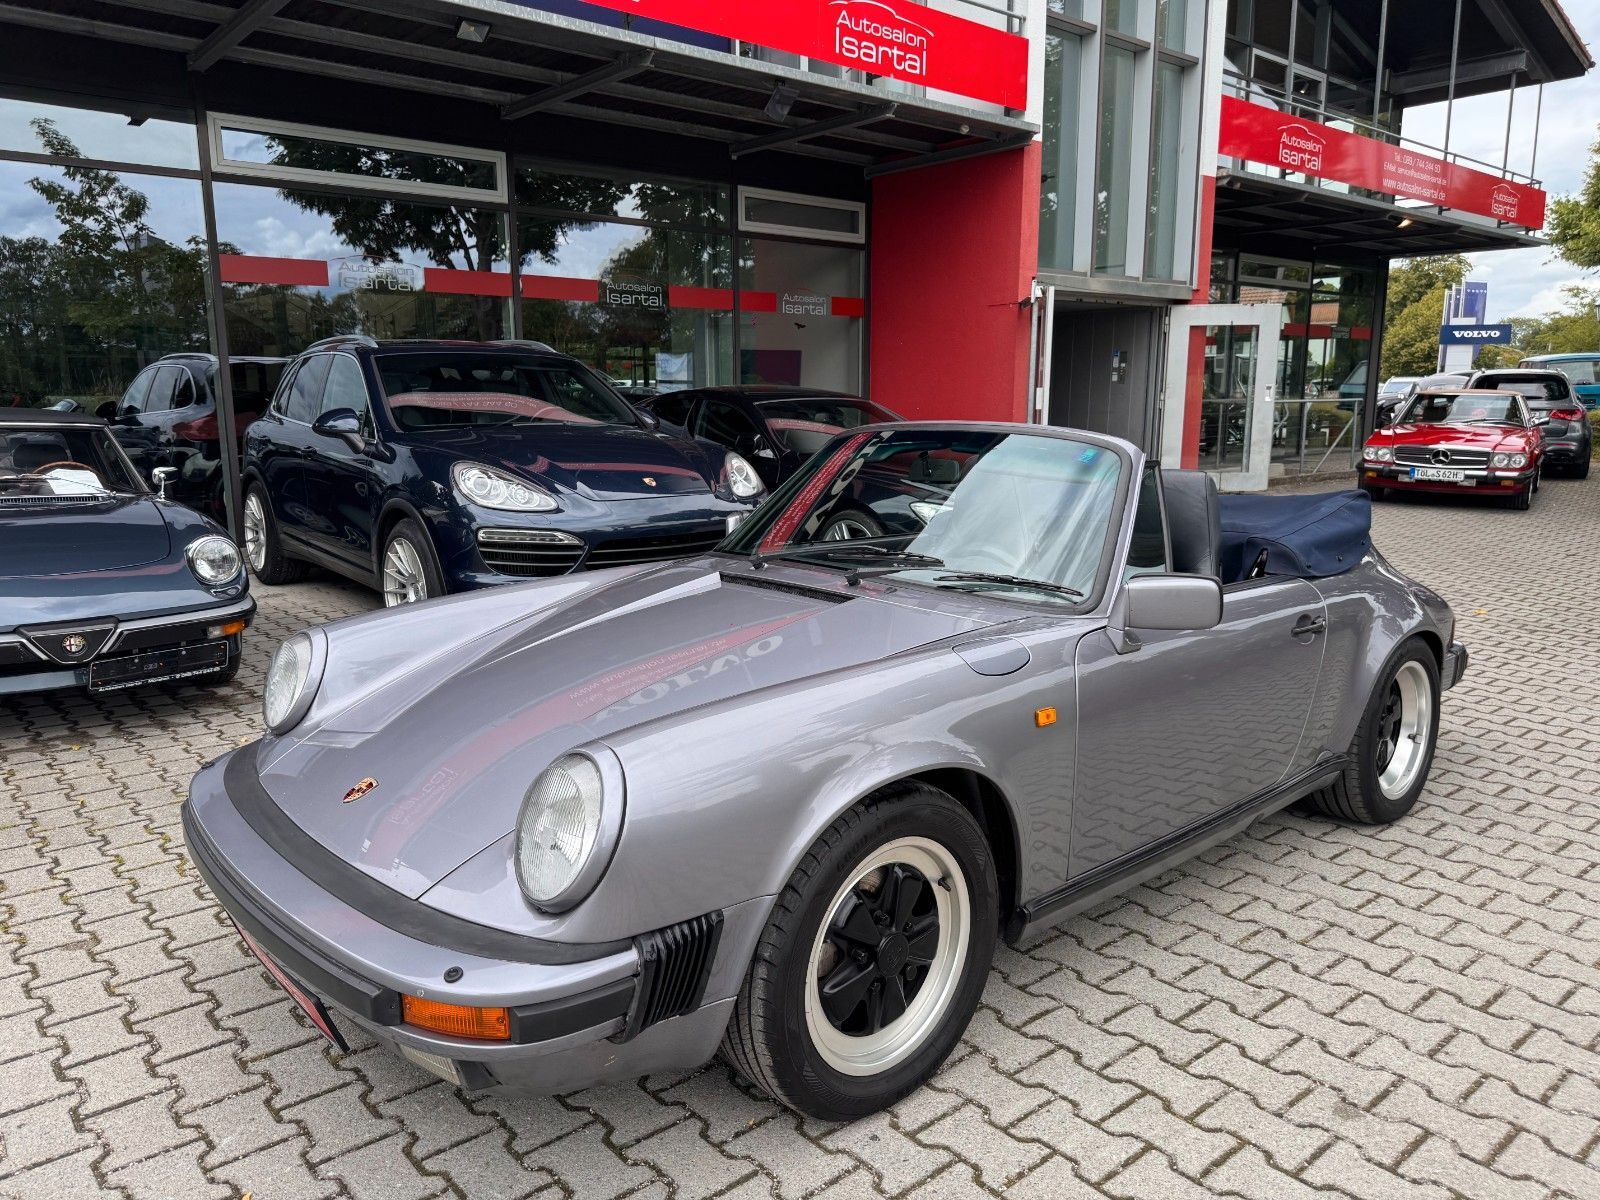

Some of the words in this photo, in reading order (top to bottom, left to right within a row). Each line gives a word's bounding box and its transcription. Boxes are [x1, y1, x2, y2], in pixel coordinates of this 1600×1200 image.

[837, 10, 926, 49] Autosalon
[836, 27, 927, 76] Isartal
[1280, 132, 1323, 153] Autosalon
[1279, 143, 1322, 171] Isartal
[1382, 178, 1446, 201] www.autosalon-isartal.de
[1493, 190, 1518, 204] Autosalon
[1491, 199, 1517, 218] Isartal
[340, 261, 415, 276] Autosalon
[338, 272, 415, 292] Isartal
[607, 281, 662, 293] Autosalon
[606, 290, 663, 307] Isartal
[783, 292, 827, 303] Autosalon
[782, 301, 827, 315] Isartal
[1453, 330, 1501, 338] VOLVO
